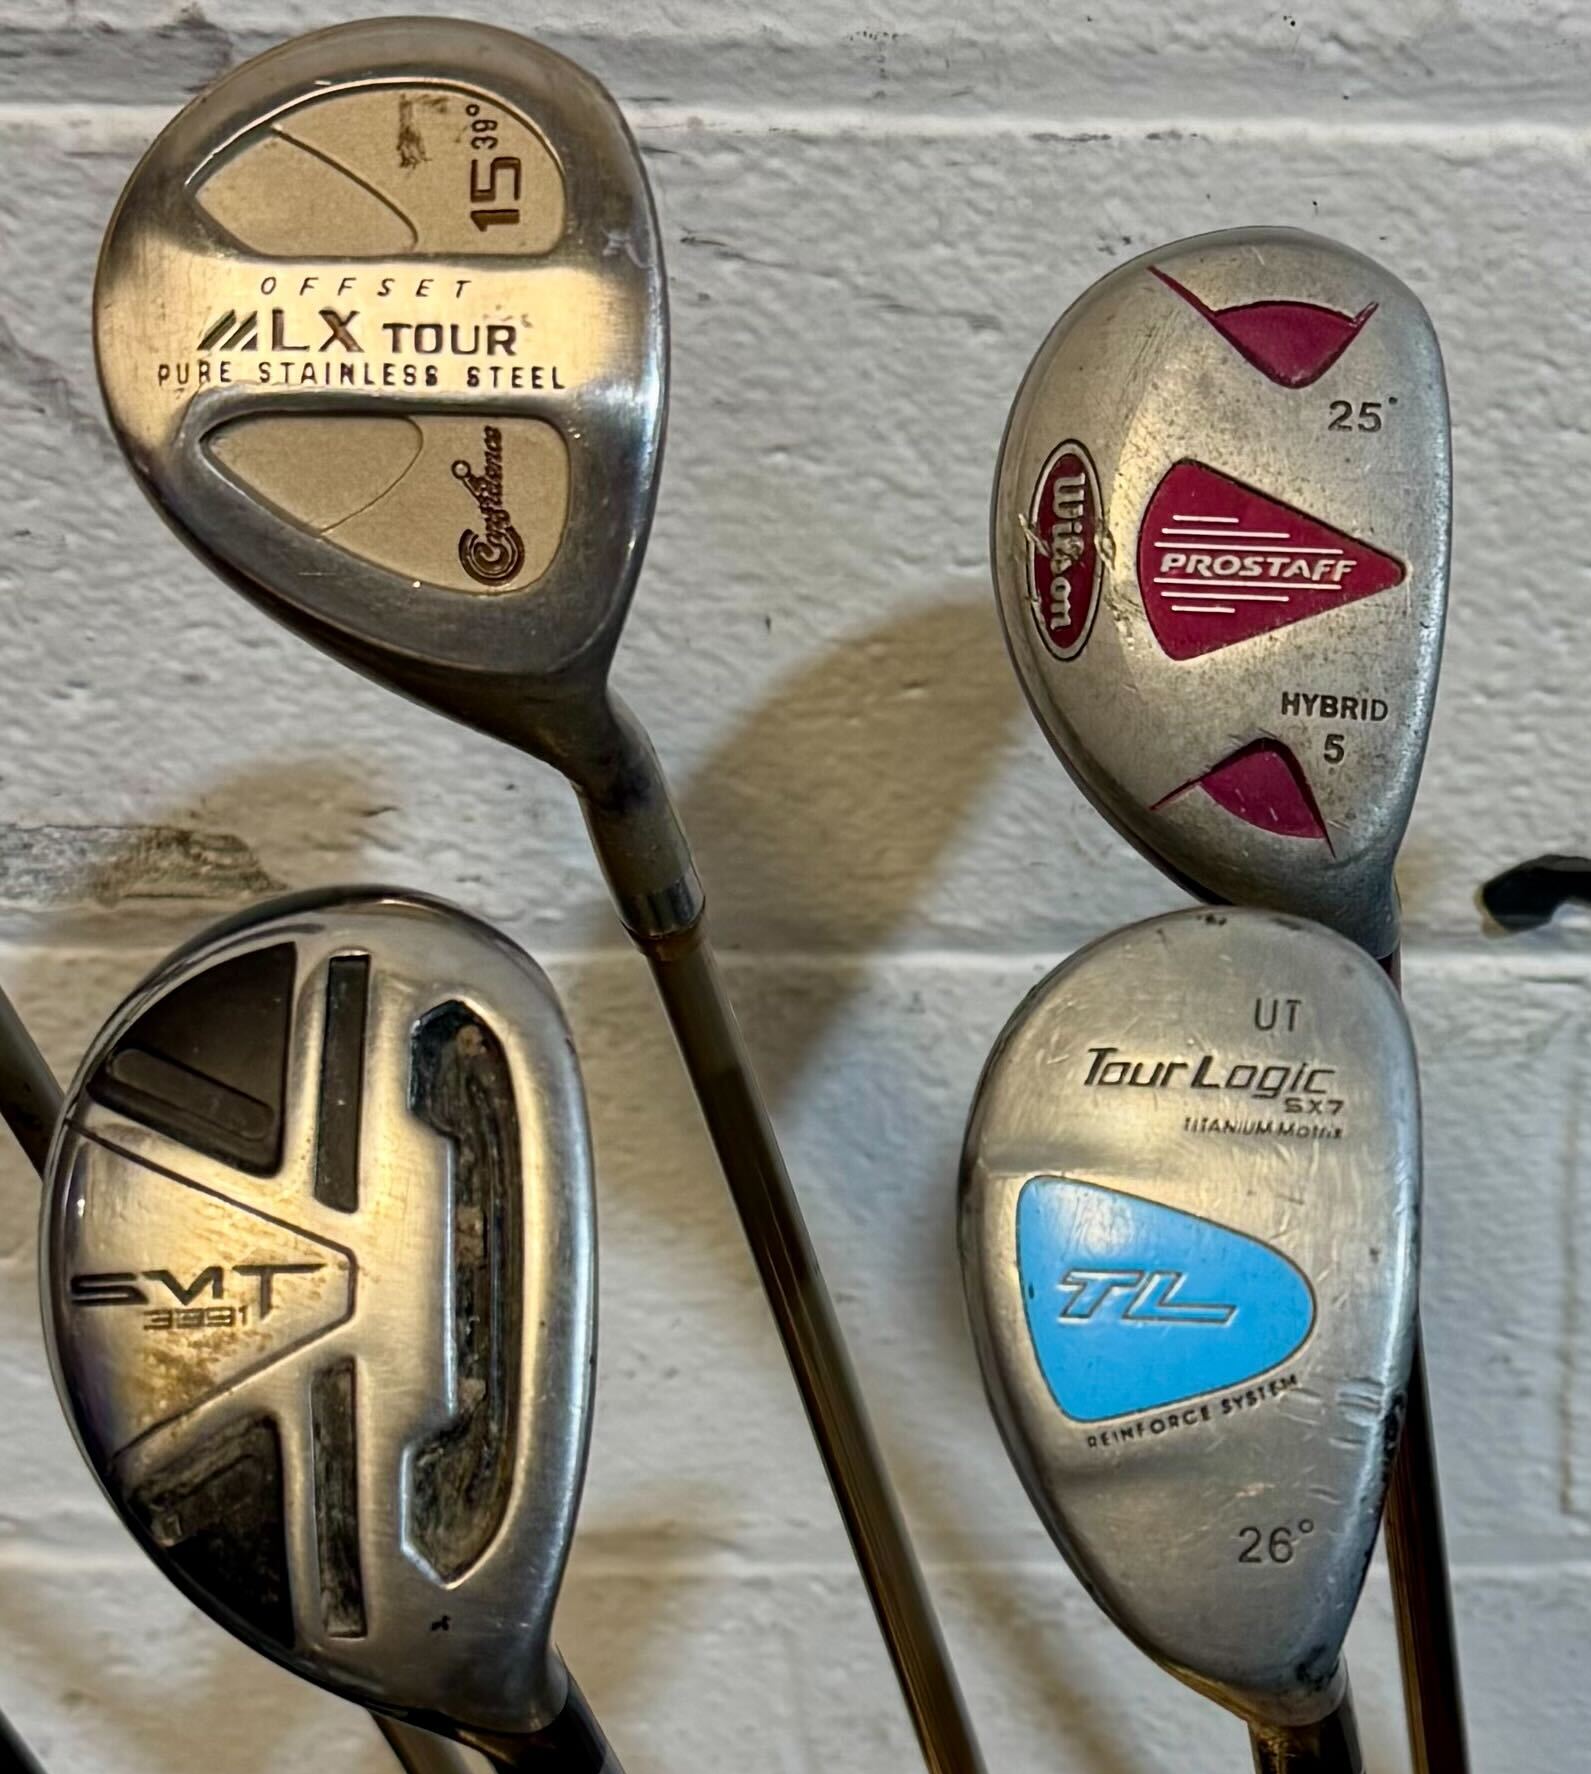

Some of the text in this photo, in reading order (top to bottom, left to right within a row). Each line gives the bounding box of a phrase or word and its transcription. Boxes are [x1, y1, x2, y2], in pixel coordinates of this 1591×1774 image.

[466, 103, 522, 232] 15 39°
[260, 276, 472, 298] OFFSET
[382, 322, 517, 356] TOUR
[157, 360, 566, 390] PURE STAINLESS STEEL
[1328, 397, 1397, 433] 25°
[451, 426, 525, 586] Confidence
[1048, 472, 1085, 632] Wilson
[1280, 692, 1388, 721] HYBRID
[1324, 734, 1344, 764] 5
[1254, 998, 1302, 1032] UT
[1087, 1374, 1298, 1448] REINFORCE SYSTEM
[1237, 1518, 1315, 1564] 26°
